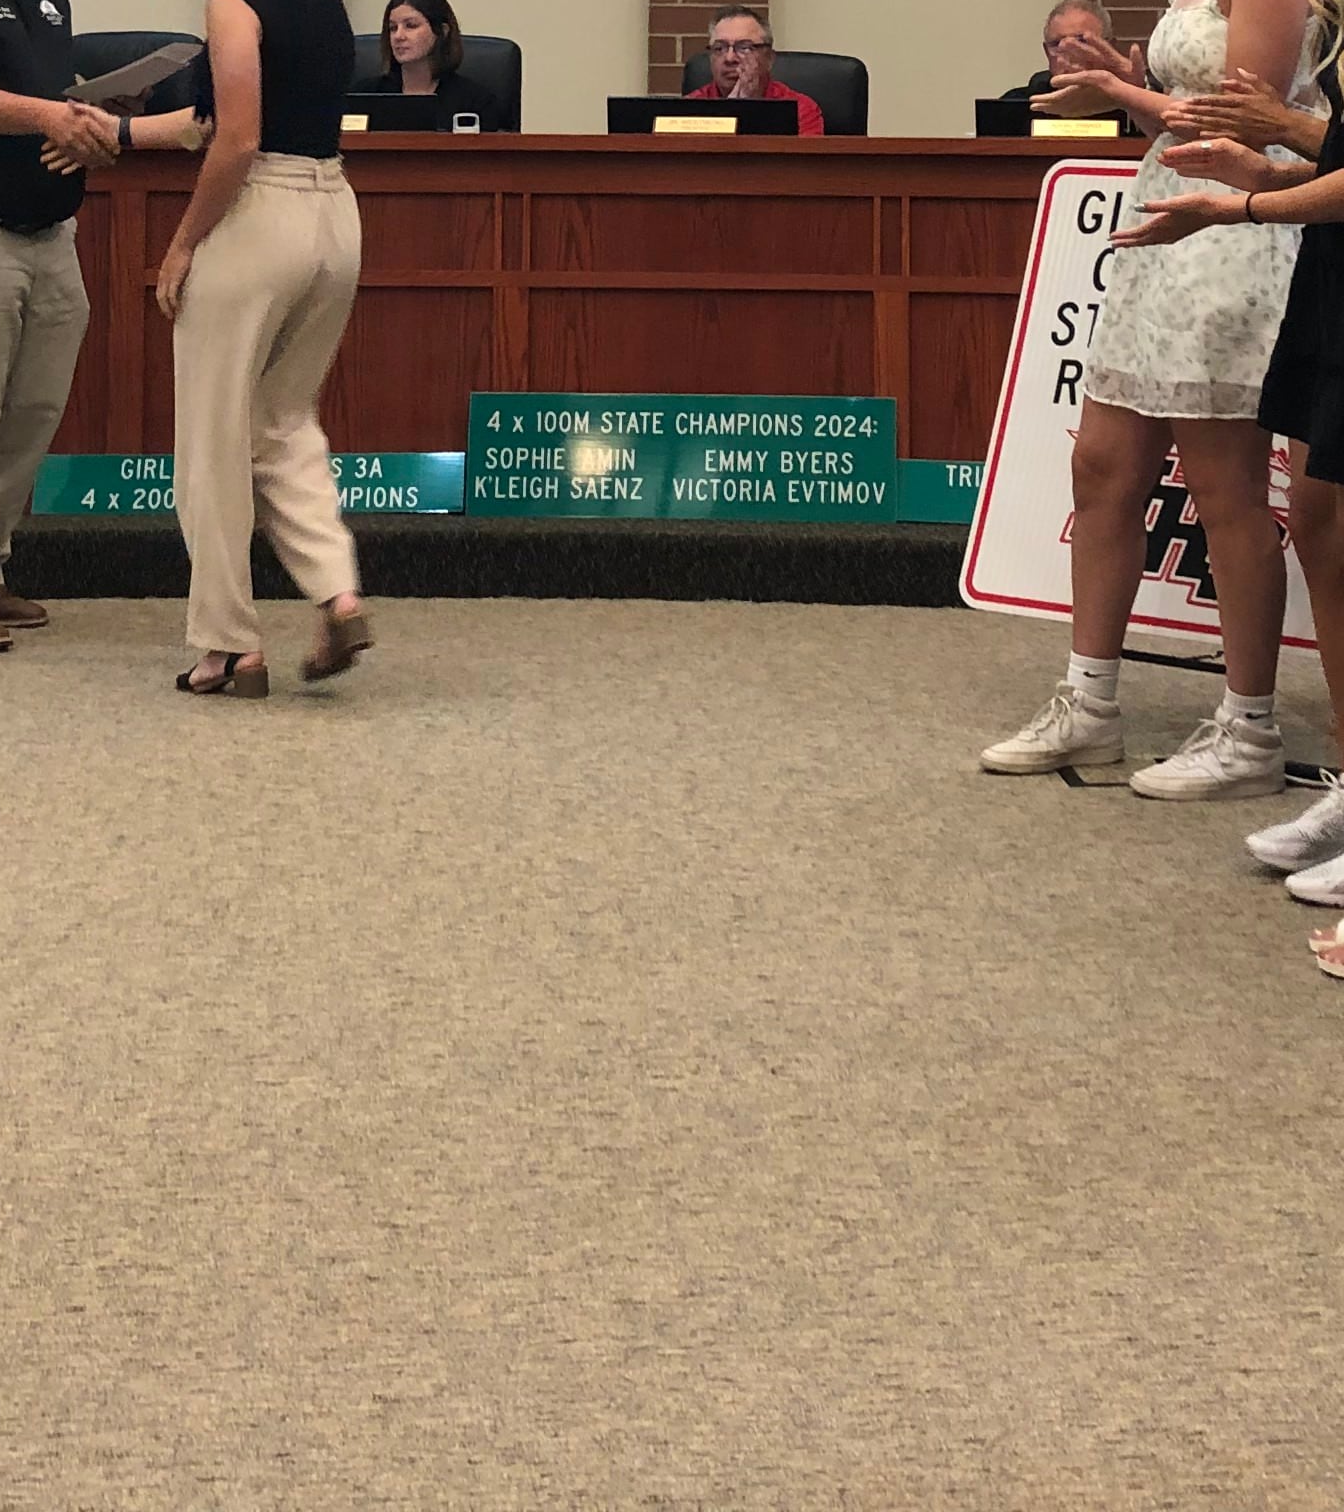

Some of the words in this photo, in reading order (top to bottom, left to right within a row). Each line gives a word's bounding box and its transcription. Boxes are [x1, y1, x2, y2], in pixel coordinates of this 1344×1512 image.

[486, 410, 501, 433] 4
[512, 415, 524, 433] x
[536, 410, 590, 434] 100M
[600, 410, 664, 435] STATE
[675, 412, 803, 437] CHAMPIONS
[814, 414, 878, 438] 2024:
[120, 457, 172, 480] GIRL
[354, 456, 383, 479] 3A
[485, 447, 566, 471] SOPHIE
[581, 447, 636, 471] AMIN
[705, 449, 768, 473] EMMY
[780, 450, 854, 475] BYERS
[80, 488, 96, 510] 4
[107, 492, 120, 510] x
[132, 488, 176, 510] 200
[336, 486, 418, 508] MPIONS
[474, 475, 559, 499] K'LEIGH
[570, 476, 644, 500] SAENZ
[673, 478, 776, 502] VICTORIA
[787, 480, 886, 505] EVTIMOV
